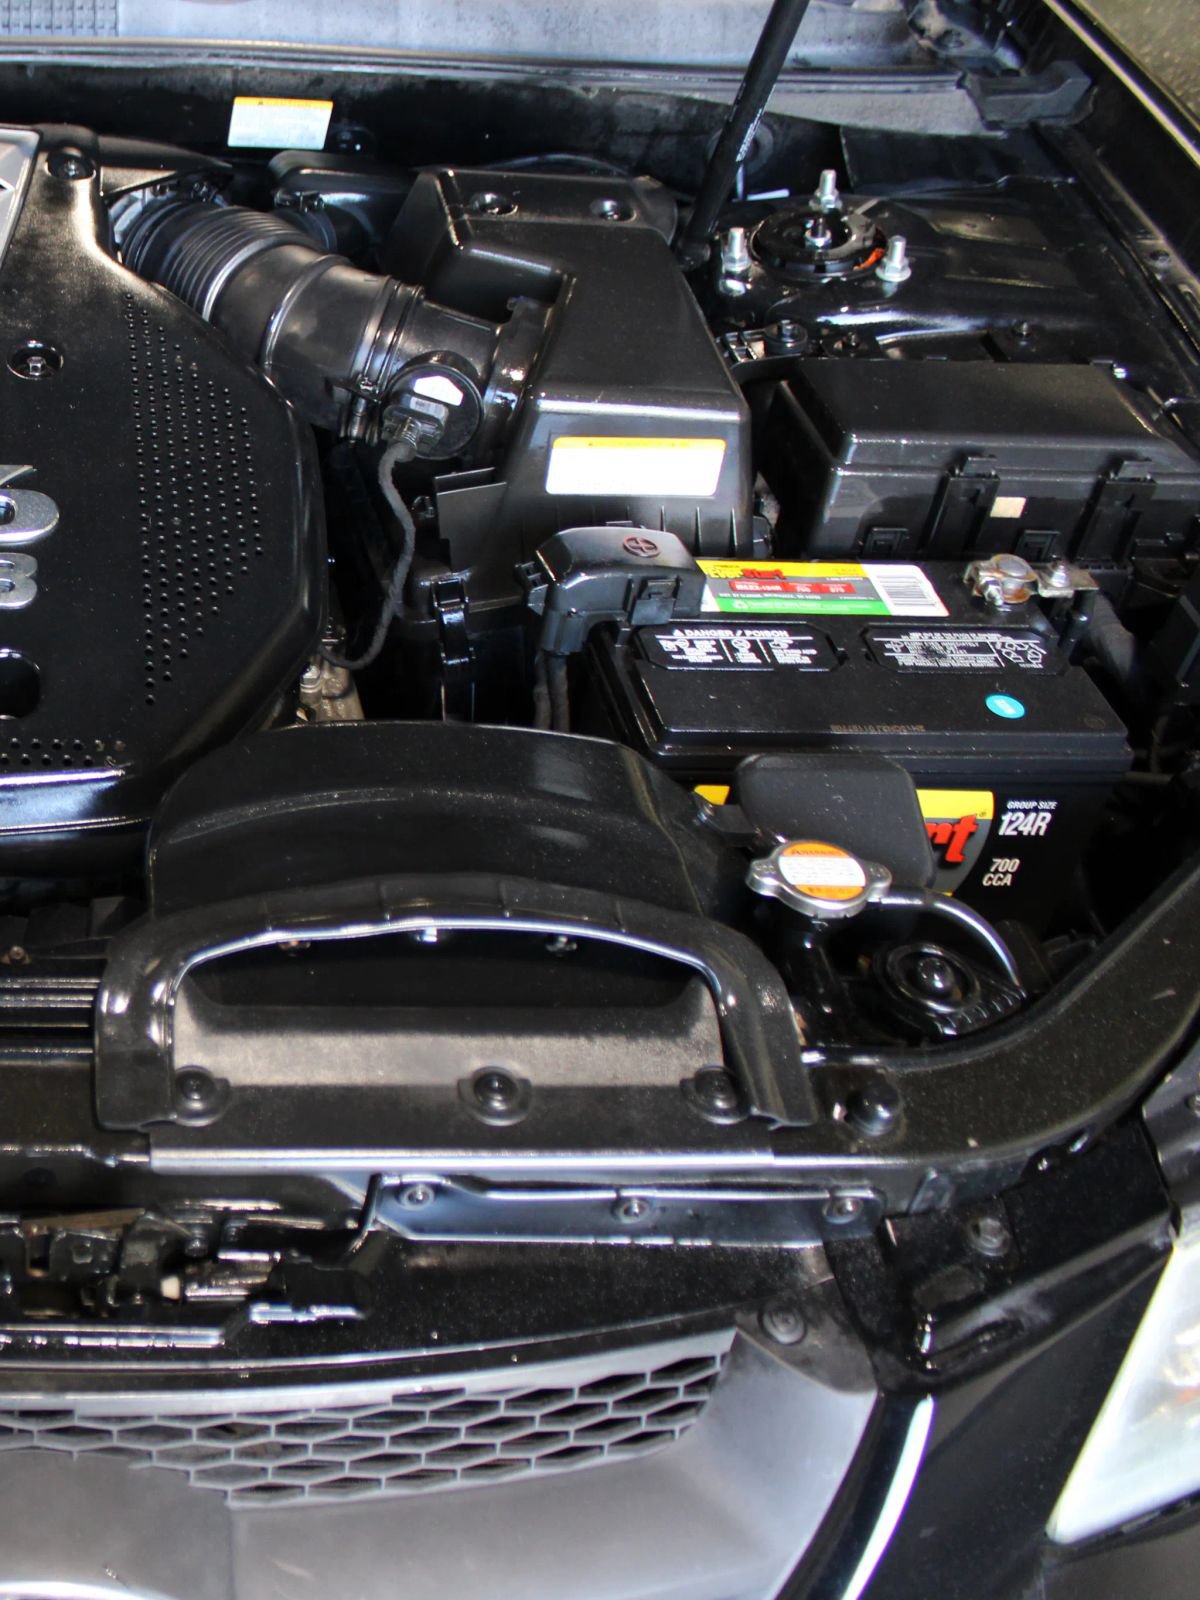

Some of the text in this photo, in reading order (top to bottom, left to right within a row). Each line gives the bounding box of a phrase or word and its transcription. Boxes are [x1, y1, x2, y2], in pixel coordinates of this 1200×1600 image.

[684, 629, 734, 638] DANGER
[744, 629, 790, 638] POISON
[1006, 800, 1058, 810] GROUP SIZE
[998, 812, 1052, 836] 124R
[990, 858, 1020, 873] 700
[982, 873, 1013, 887] CCA
